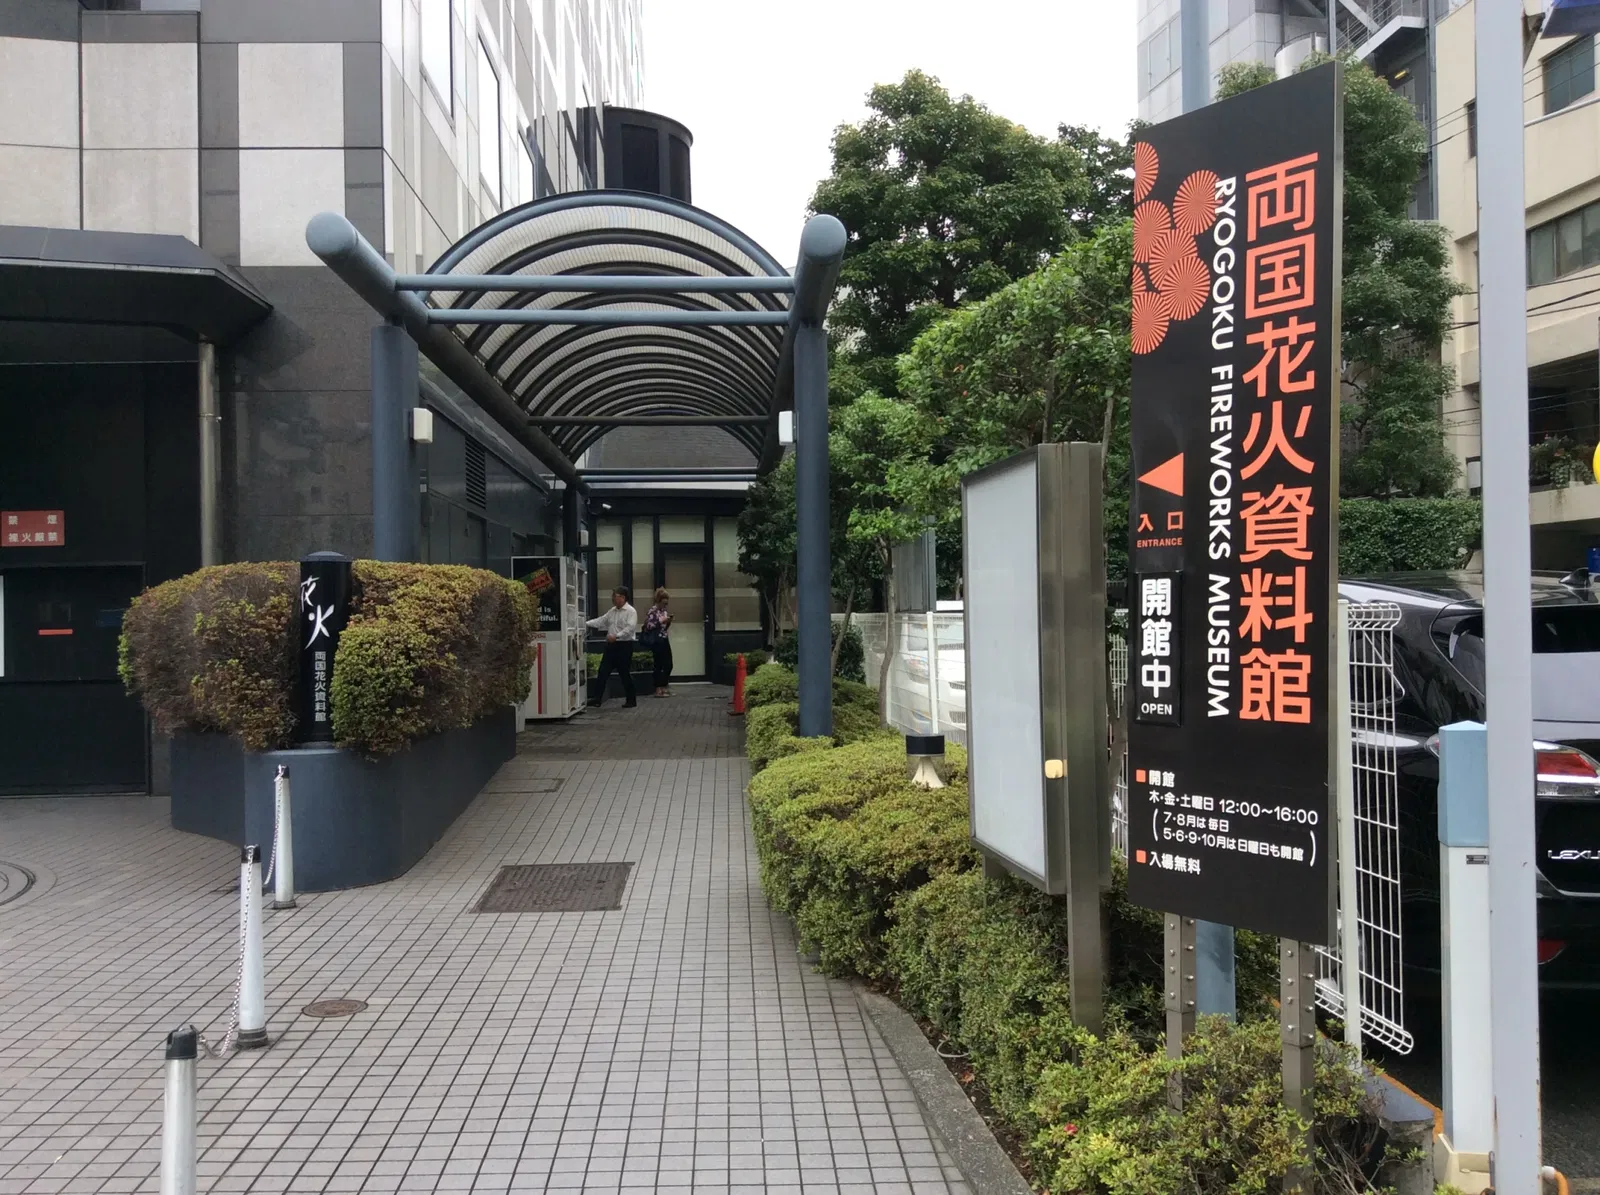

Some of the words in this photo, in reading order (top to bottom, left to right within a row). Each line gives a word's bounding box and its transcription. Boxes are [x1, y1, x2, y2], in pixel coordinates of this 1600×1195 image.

[1211, 176, 1236, 351] RYOGOKU
[1209, 364, 1233, 560] FIREWORKS
[1239, 152, 1318, 723] 両国花火資料館
[1136, 537, 1183, 548] ENTRANCE
[1137, 511, 1184, 533] 入口
[1141, 578, 1172, 698] 開館中
[1207, 573, 1230, 717] MUSEUM
[314, 651, 326, 722] 両国花火資料館
[1141, 702, 1173, 716] OPEN
[1149, 770, 1175, 788] 開館
[1149, 852, 1201, 875] 入場無料
